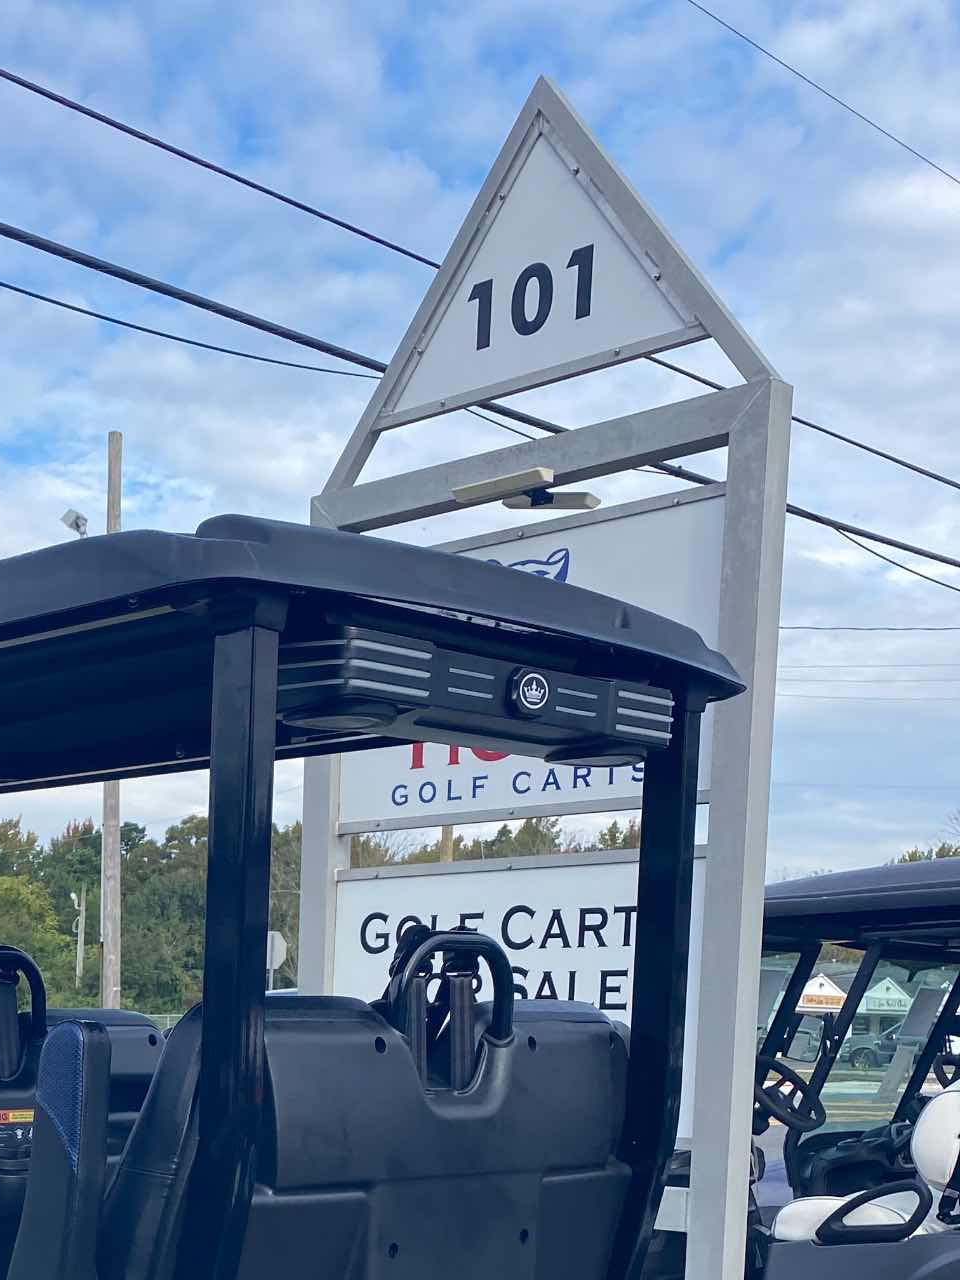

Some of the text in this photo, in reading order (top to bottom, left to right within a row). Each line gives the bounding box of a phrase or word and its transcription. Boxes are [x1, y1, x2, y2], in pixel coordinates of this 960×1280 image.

[467, 243, 594, 351] 101
[391, 761, 644, 806] GOLF CARTS
